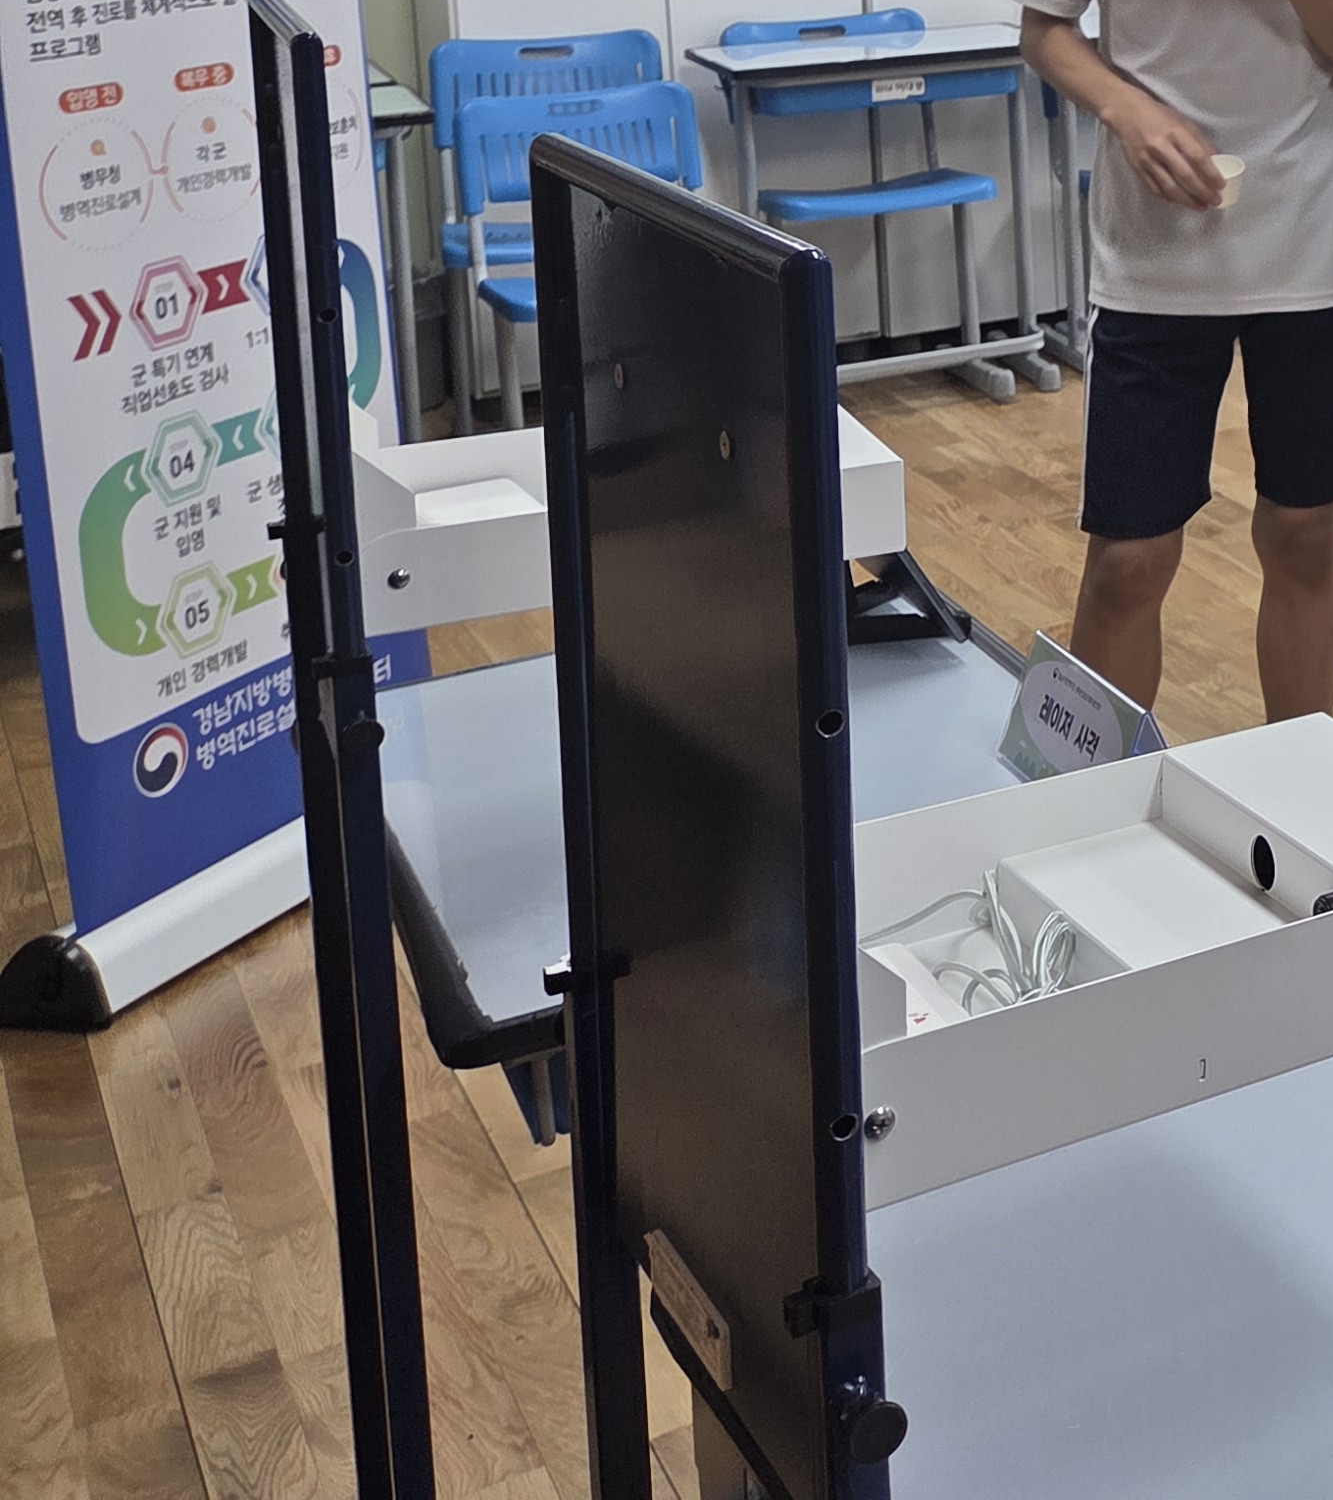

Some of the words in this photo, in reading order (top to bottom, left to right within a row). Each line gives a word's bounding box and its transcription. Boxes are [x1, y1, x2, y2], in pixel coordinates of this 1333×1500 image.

[26, 8, 65, 34] 전역
[70, 5, 87, 28] 후
[29, 32, 102, 62] 프로그램
[65, 88, 98, 112] 입영
[101, 84, 118, 105] 전
[80, 164, 122, 190] 병무청
[59, 187, 143, 223] 병역진로설계
[155, 292, 179, 320] 01
[131, 362, 147, 388] 군
[151, 352, 181, 379] 특기
[184, 341, 215, 370] 연계
[121, 374, 196, 416] 직업선호도
[199, 362, 229, 392] 검사
[169, 449, 196, 478] 04
[247, 479, 263, 504] 군
[154, 515, 170, 541] 군
[173, 501, 204, 530] 지원
[175, 527, 206, 558] 입영
[184, 598, 211, 630] 05
[156, 669, 188, 698] 개인
[190, 637, 249, 684] 경력개발
[191, 665, 293, 736] 경남지방병
[1038, 693, 1075, 741] 레이저
[1073, 723, 1100, 763] 사격
